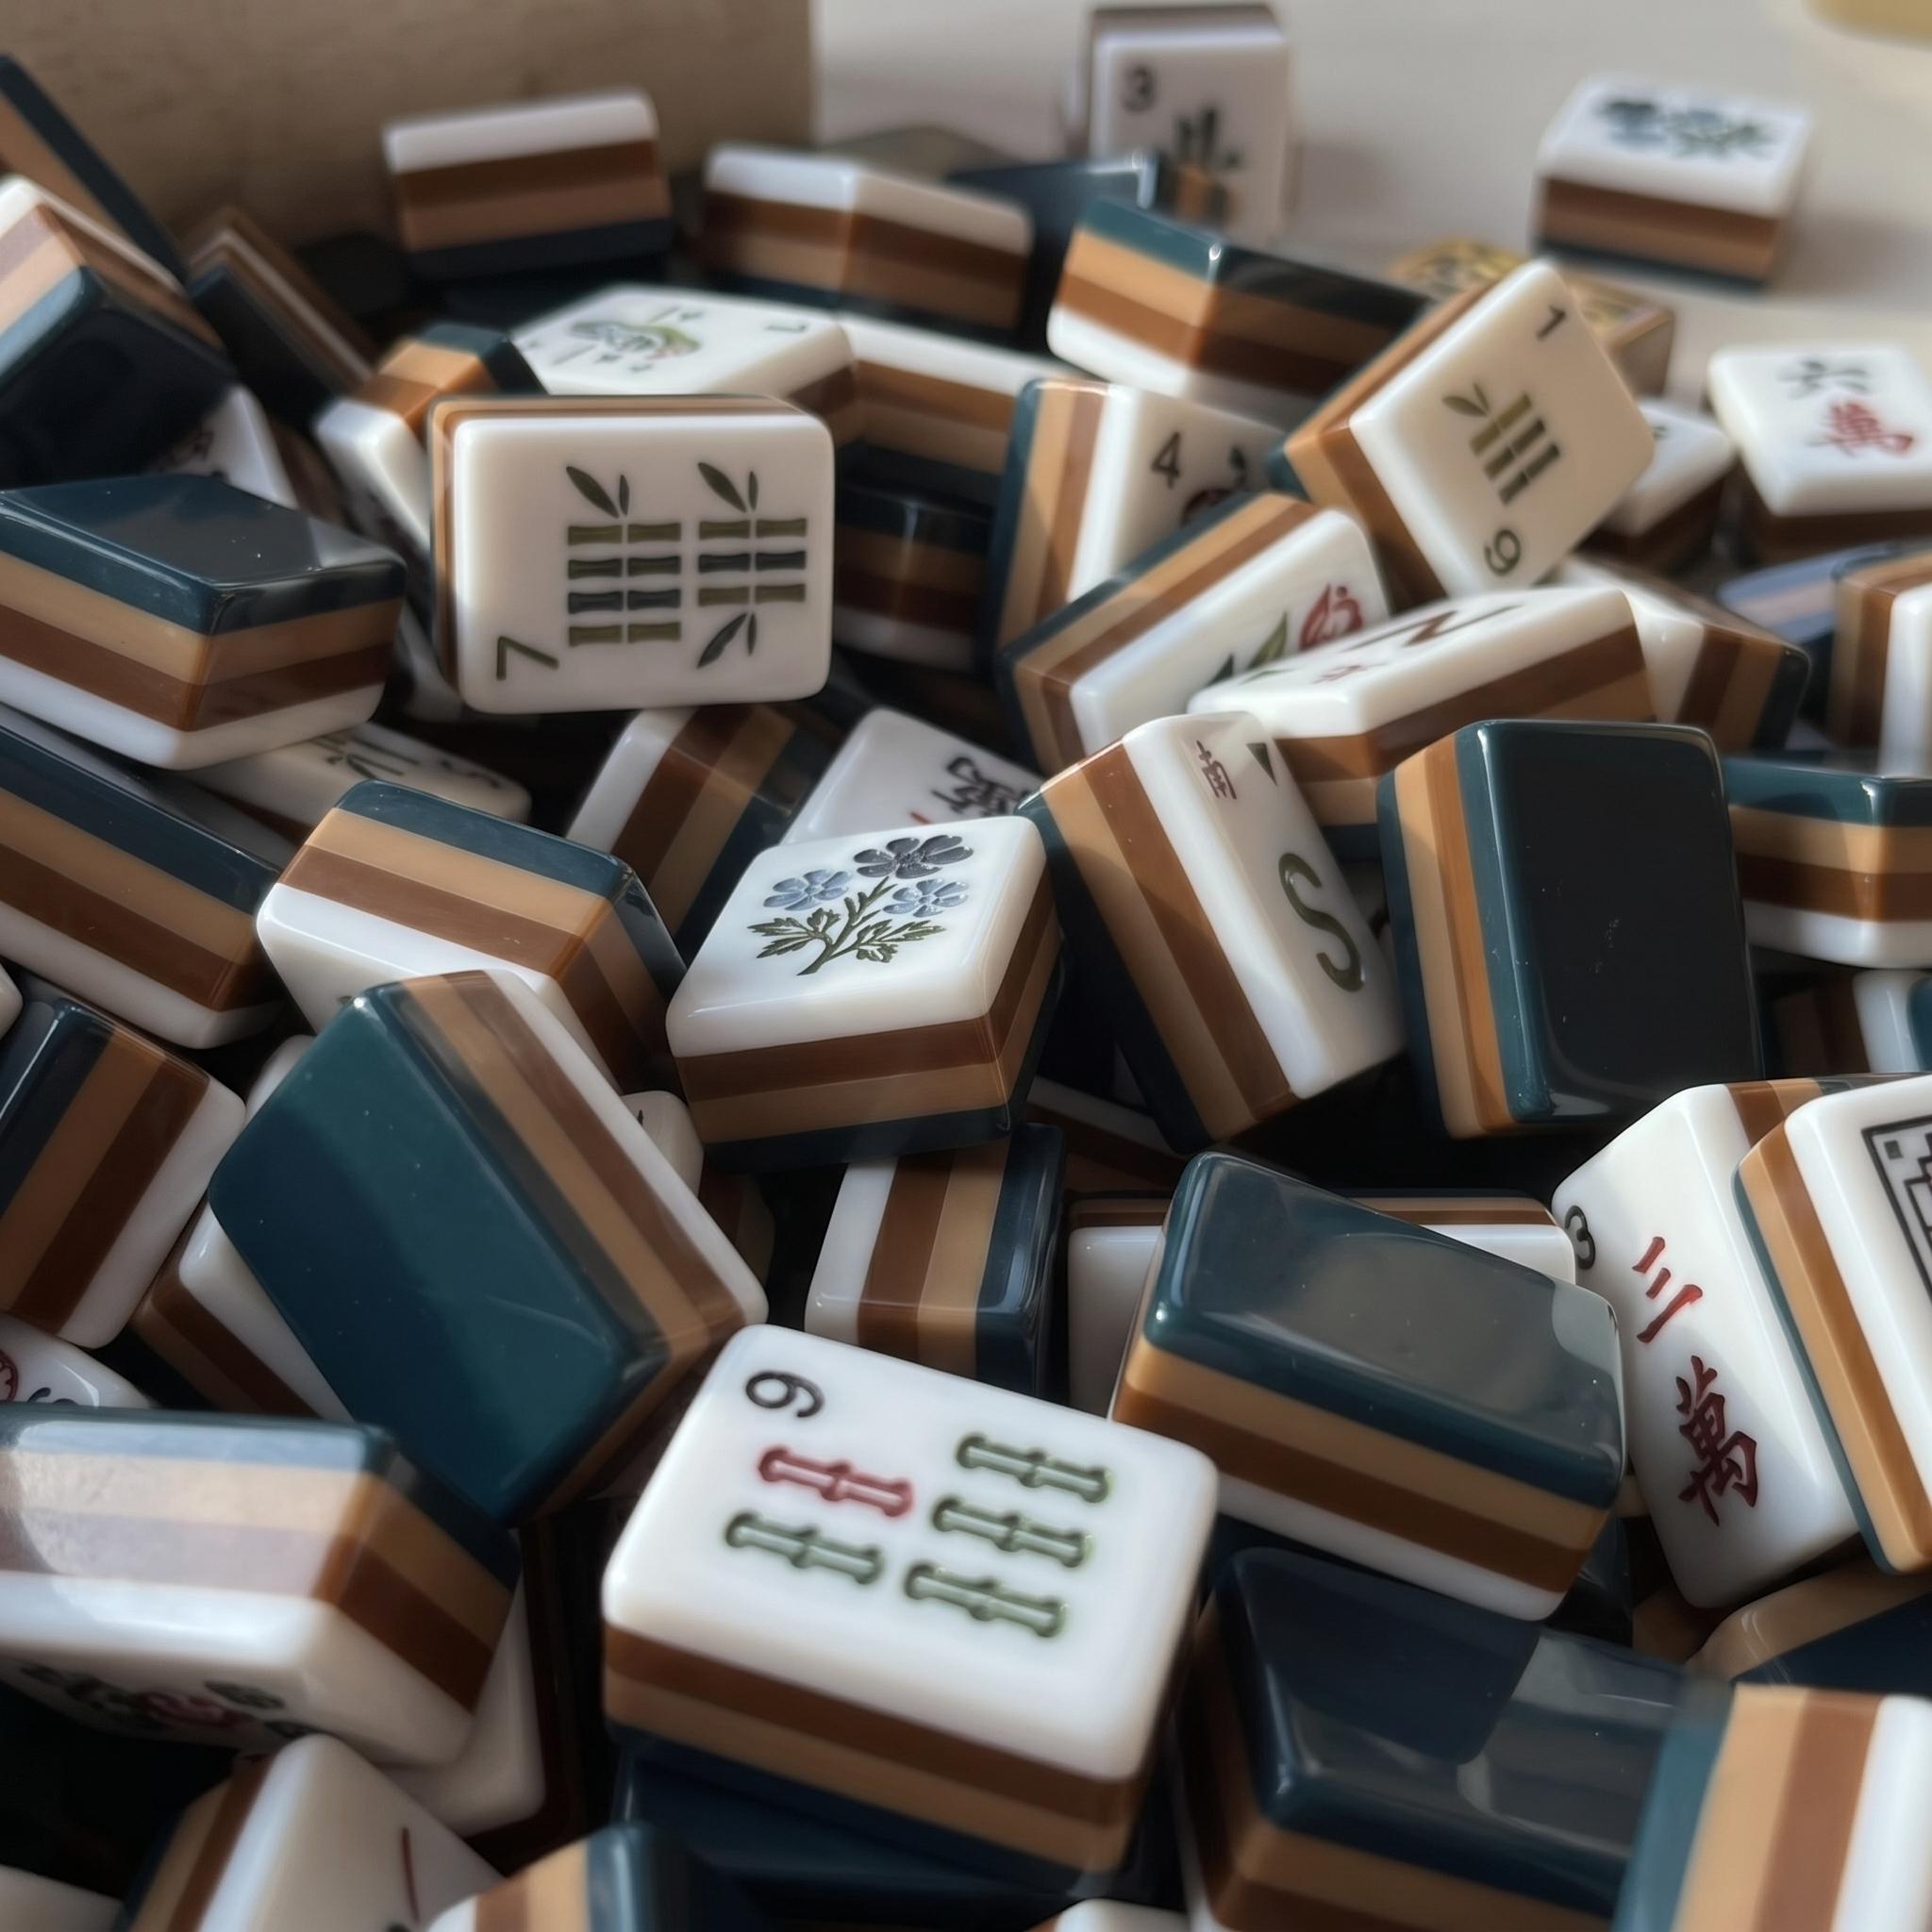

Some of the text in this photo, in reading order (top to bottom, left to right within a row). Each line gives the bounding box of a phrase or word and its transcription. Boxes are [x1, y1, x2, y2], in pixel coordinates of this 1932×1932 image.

[1150, 432, 1181, 490] 4
[496, 635, 560, 681] 7
[1277, 853, 1365, 993] S
[1563, 1205, 1596, 1271] 3
